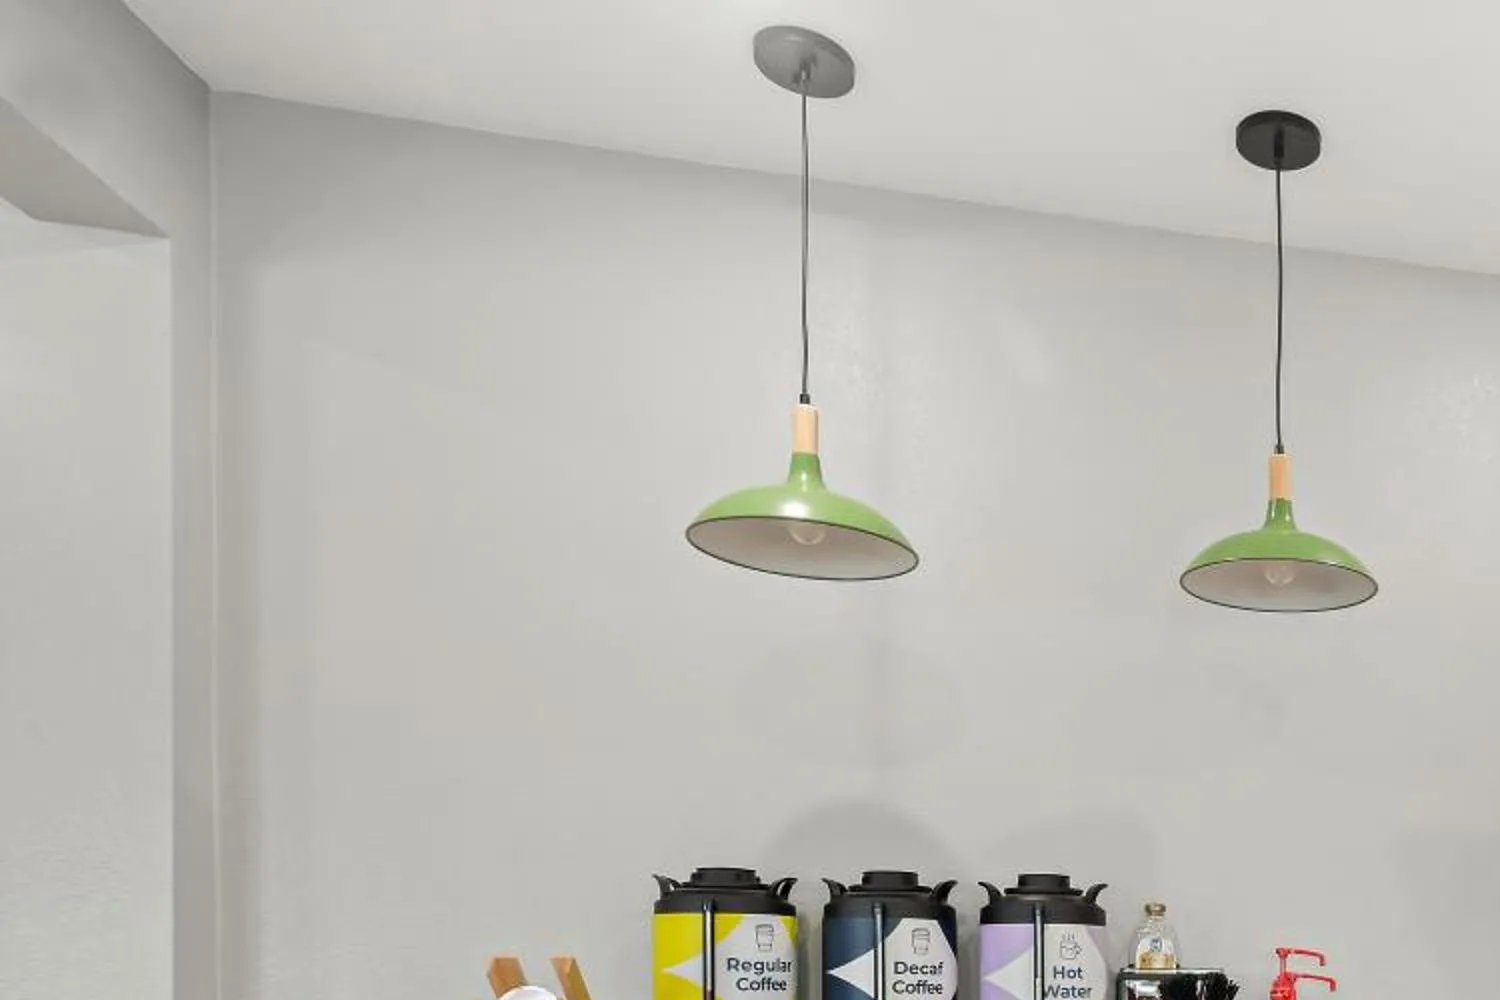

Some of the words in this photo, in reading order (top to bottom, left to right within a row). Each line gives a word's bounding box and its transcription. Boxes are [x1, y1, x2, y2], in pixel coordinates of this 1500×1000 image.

[726, 956, 793, 976] Regular
[892, 960, 945, 976] Decaf
[1052, 965, 1084, 981] Hot
[735, 976, 788, 992] Coffee
[891, 980, 945, 995] Coffee
[1043, 984, 1093, 999] Water
